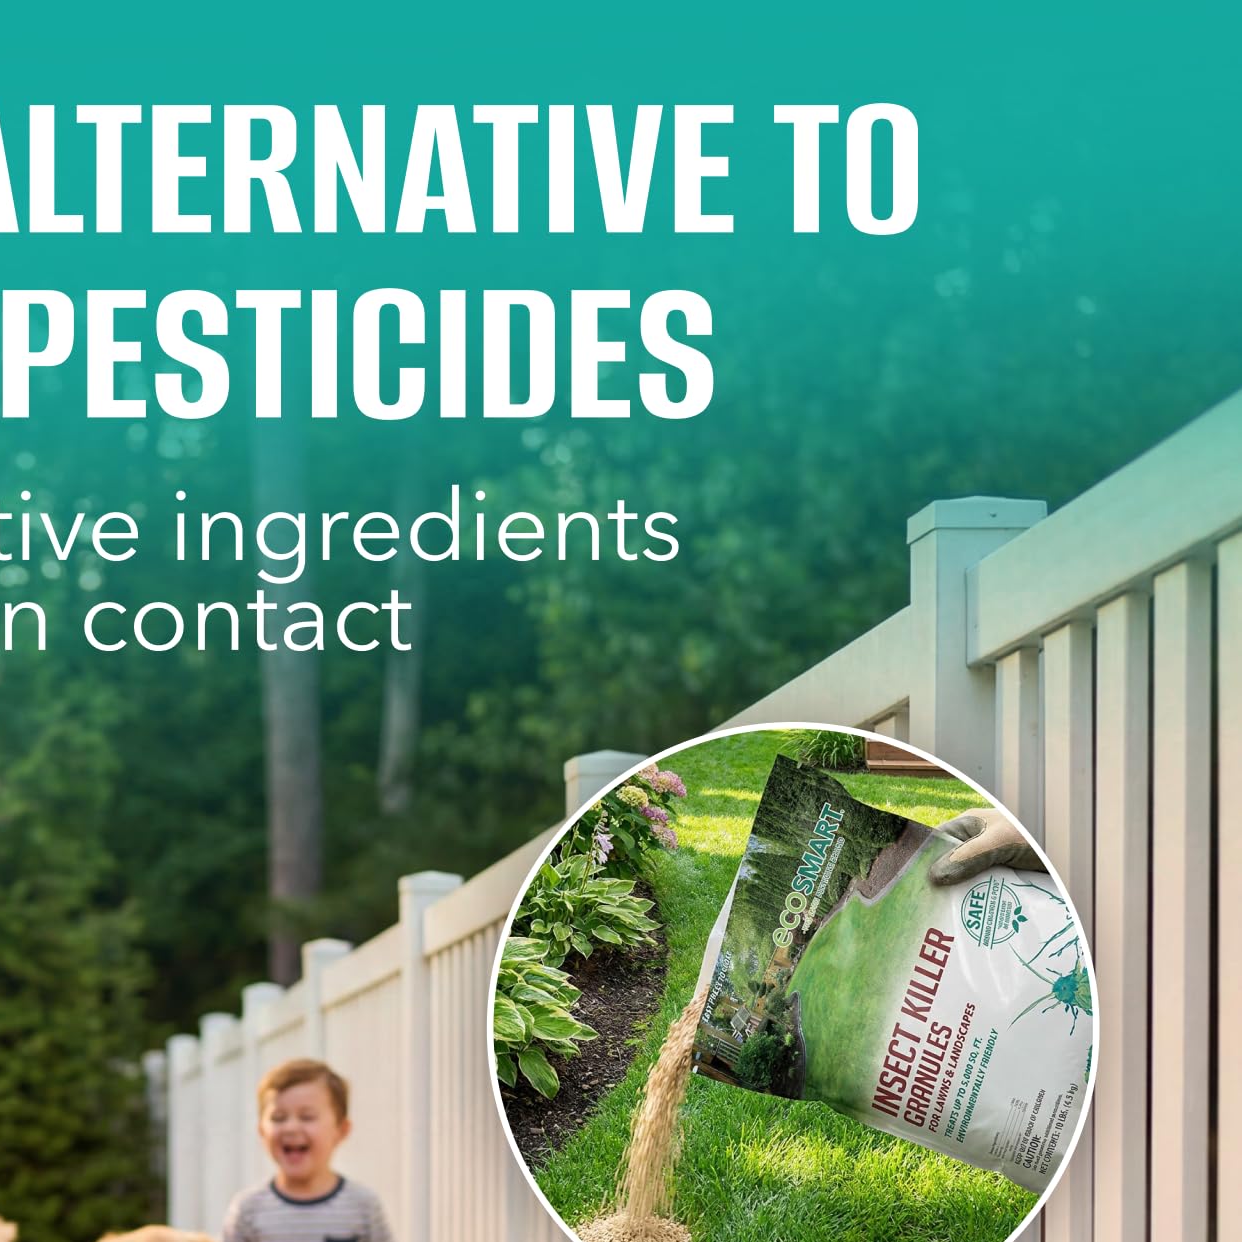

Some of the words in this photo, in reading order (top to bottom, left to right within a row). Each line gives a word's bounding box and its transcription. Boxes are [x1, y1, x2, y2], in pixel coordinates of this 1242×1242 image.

[966, 889, 985, 929] SAFE
[871, 1022, 918, 1117] INSECT
[901, 928, 954, 1022] KILLER
[948, 1003, 975, 1068] LANDSCAPES
[902, 1022, 952, 1127] GRANULES
[934, 1078, 951, 1113] LAWNS
[945, 1070, 954, 1078] &
[953, 1099, 961, 1110] UP
[957, 1088, 965, 1098] TO
[961, 1064, 973, 1087] 5,000
[928, 1114, 941, 1132] FOR
